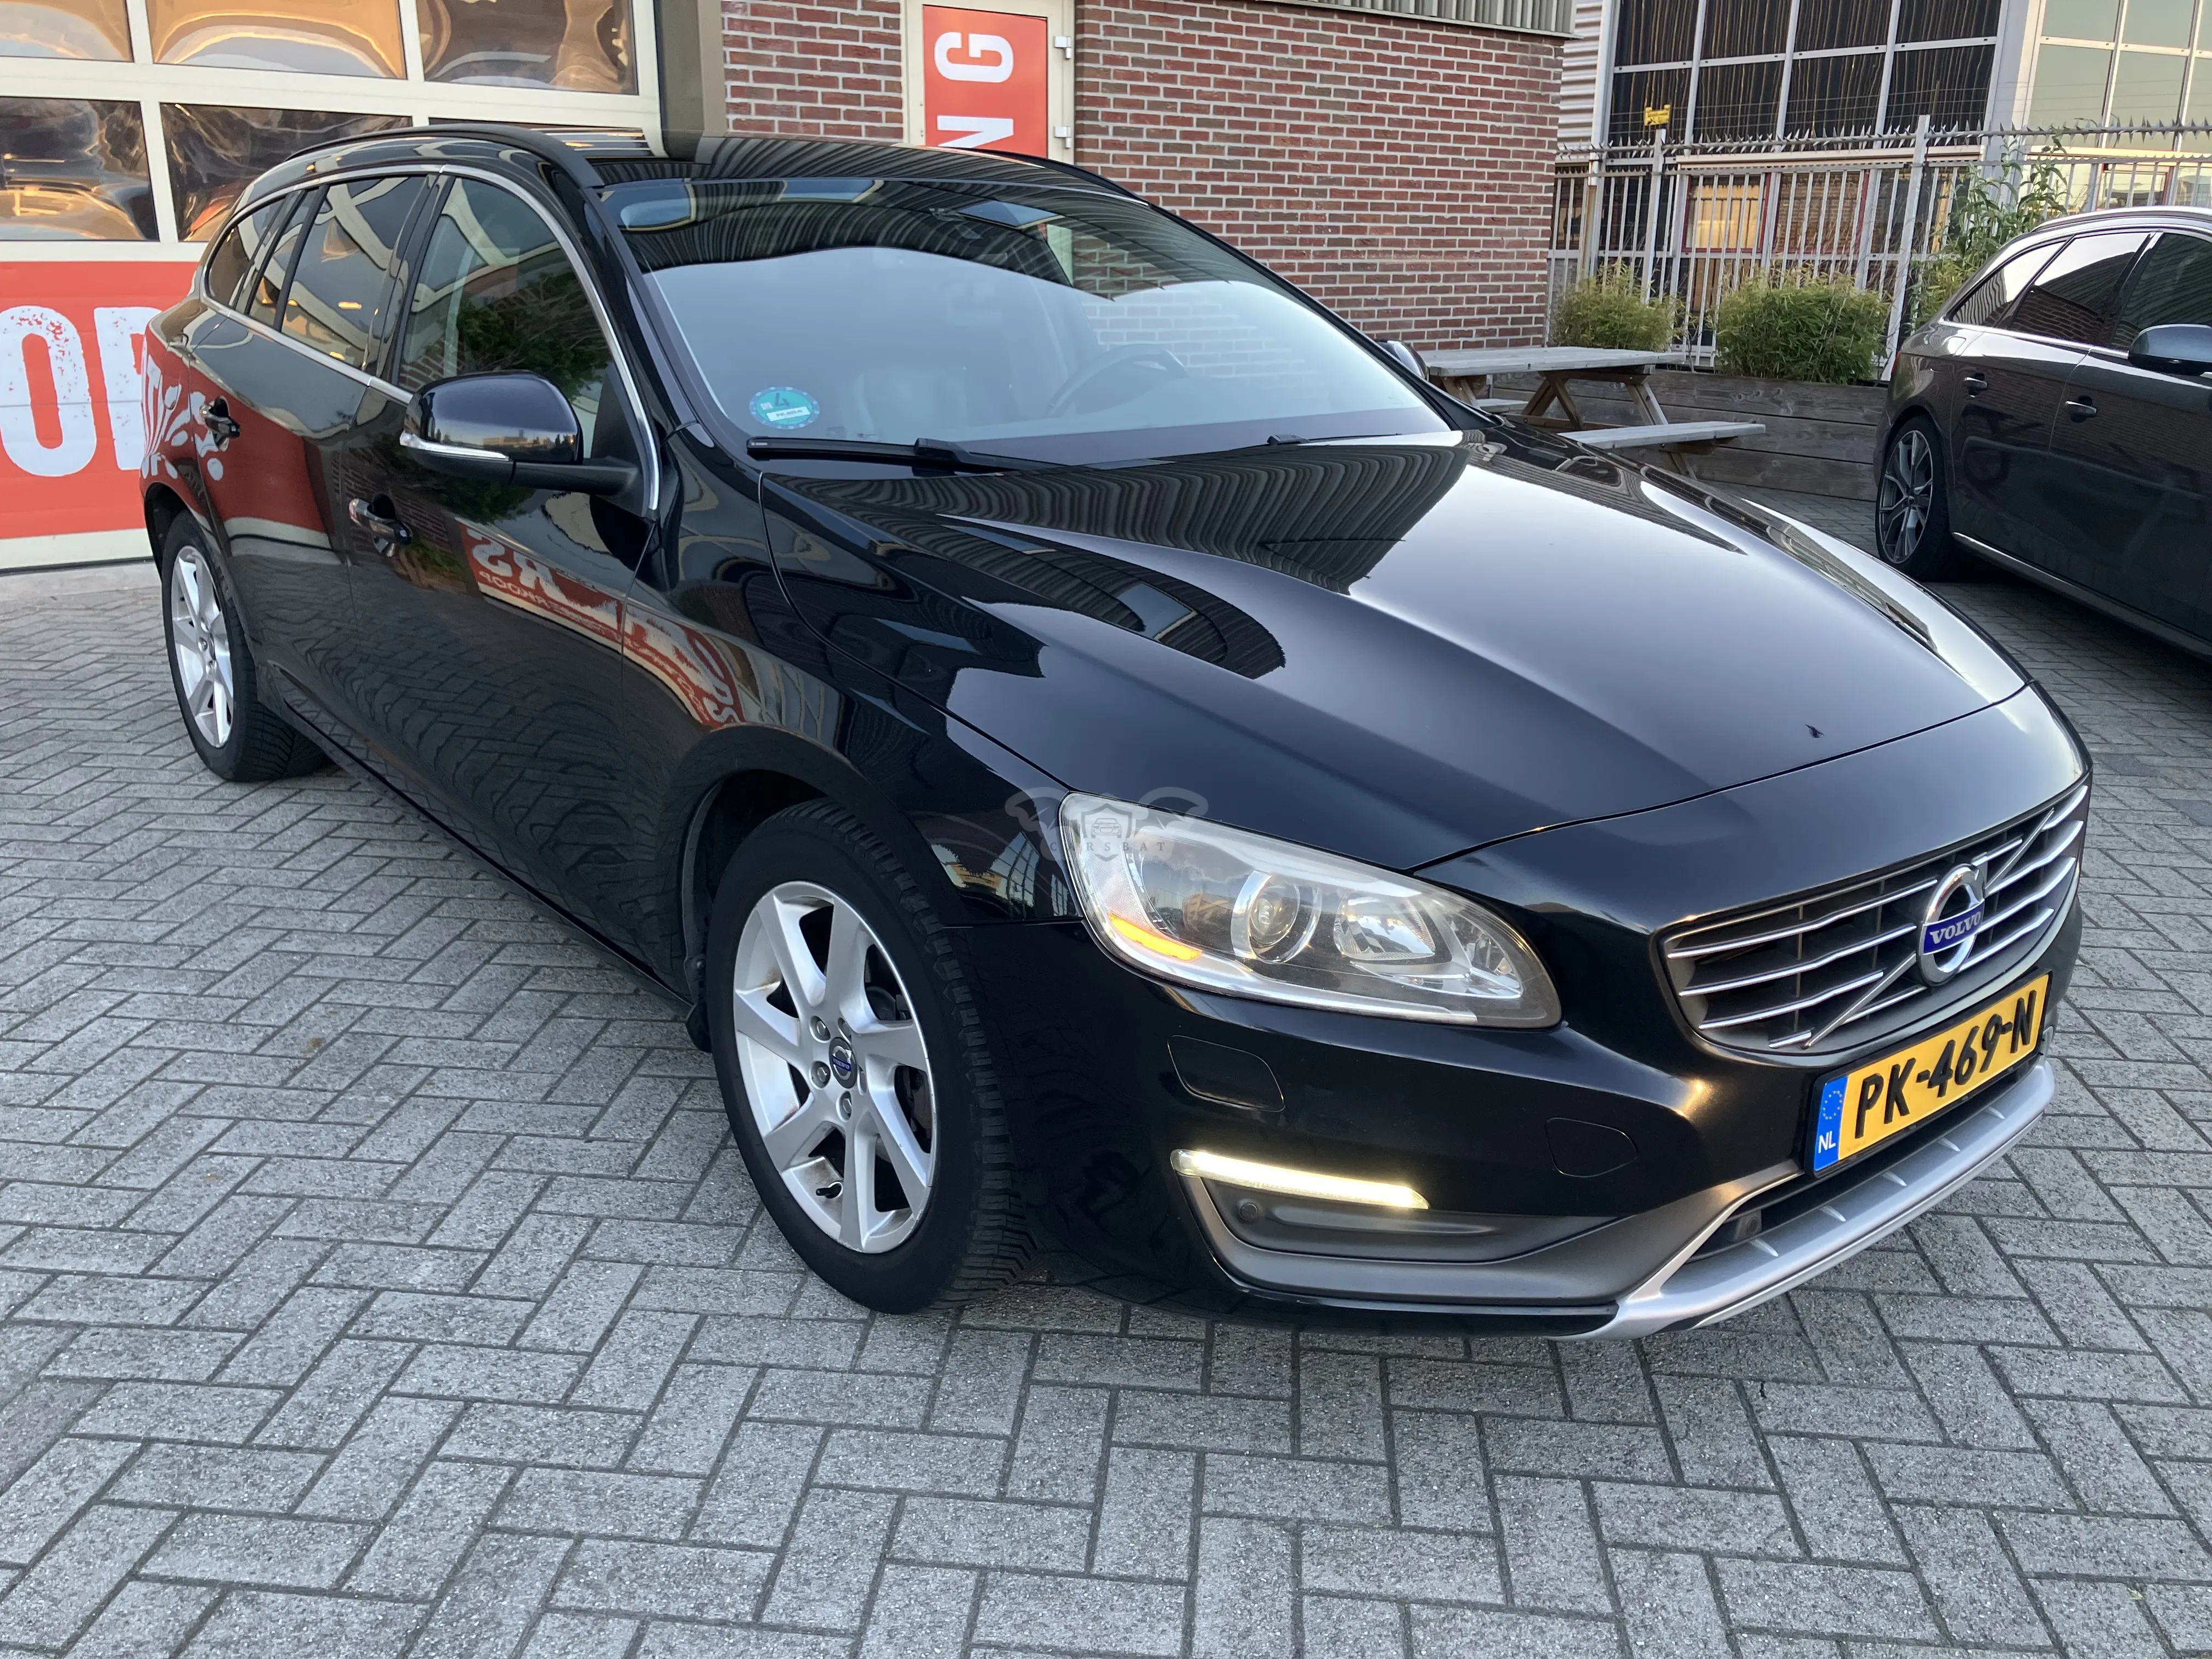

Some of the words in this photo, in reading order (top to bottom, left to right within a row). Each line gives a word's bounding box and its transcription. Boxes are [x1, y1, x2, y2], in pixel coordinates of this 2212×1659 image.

[1929, 911, 1982, 944] VOLVO
[1854, 990, 2037, 1139] PK-469-N
[1818, 1130, 1836, 1154] NL
